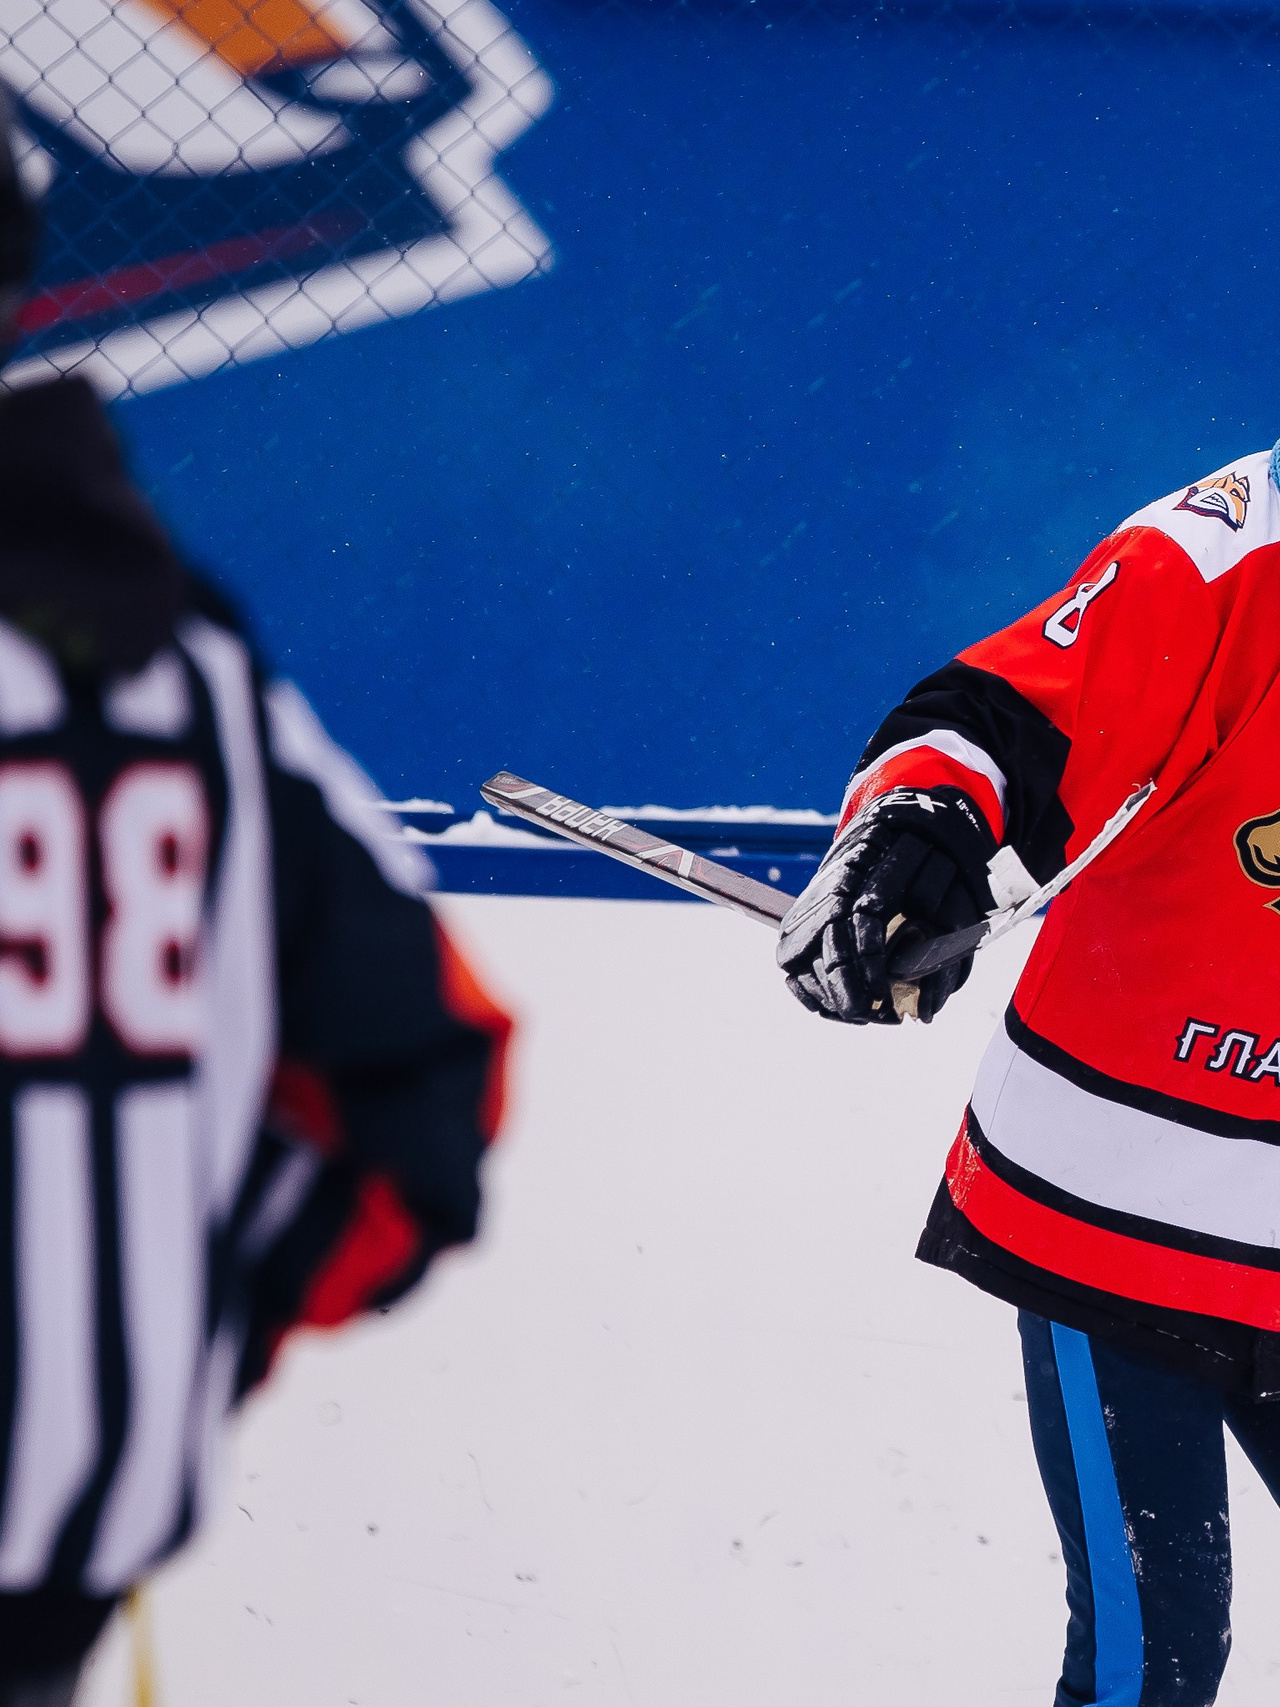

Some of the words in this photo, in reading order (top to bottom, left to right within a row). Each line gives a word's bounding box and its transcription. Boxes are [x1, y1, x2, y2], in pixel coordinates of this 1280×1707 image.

[1042, 560, 1121, 650] 8
[535, 795, 629, 841] BAUER
[0, 758, 212, 1058] 98
